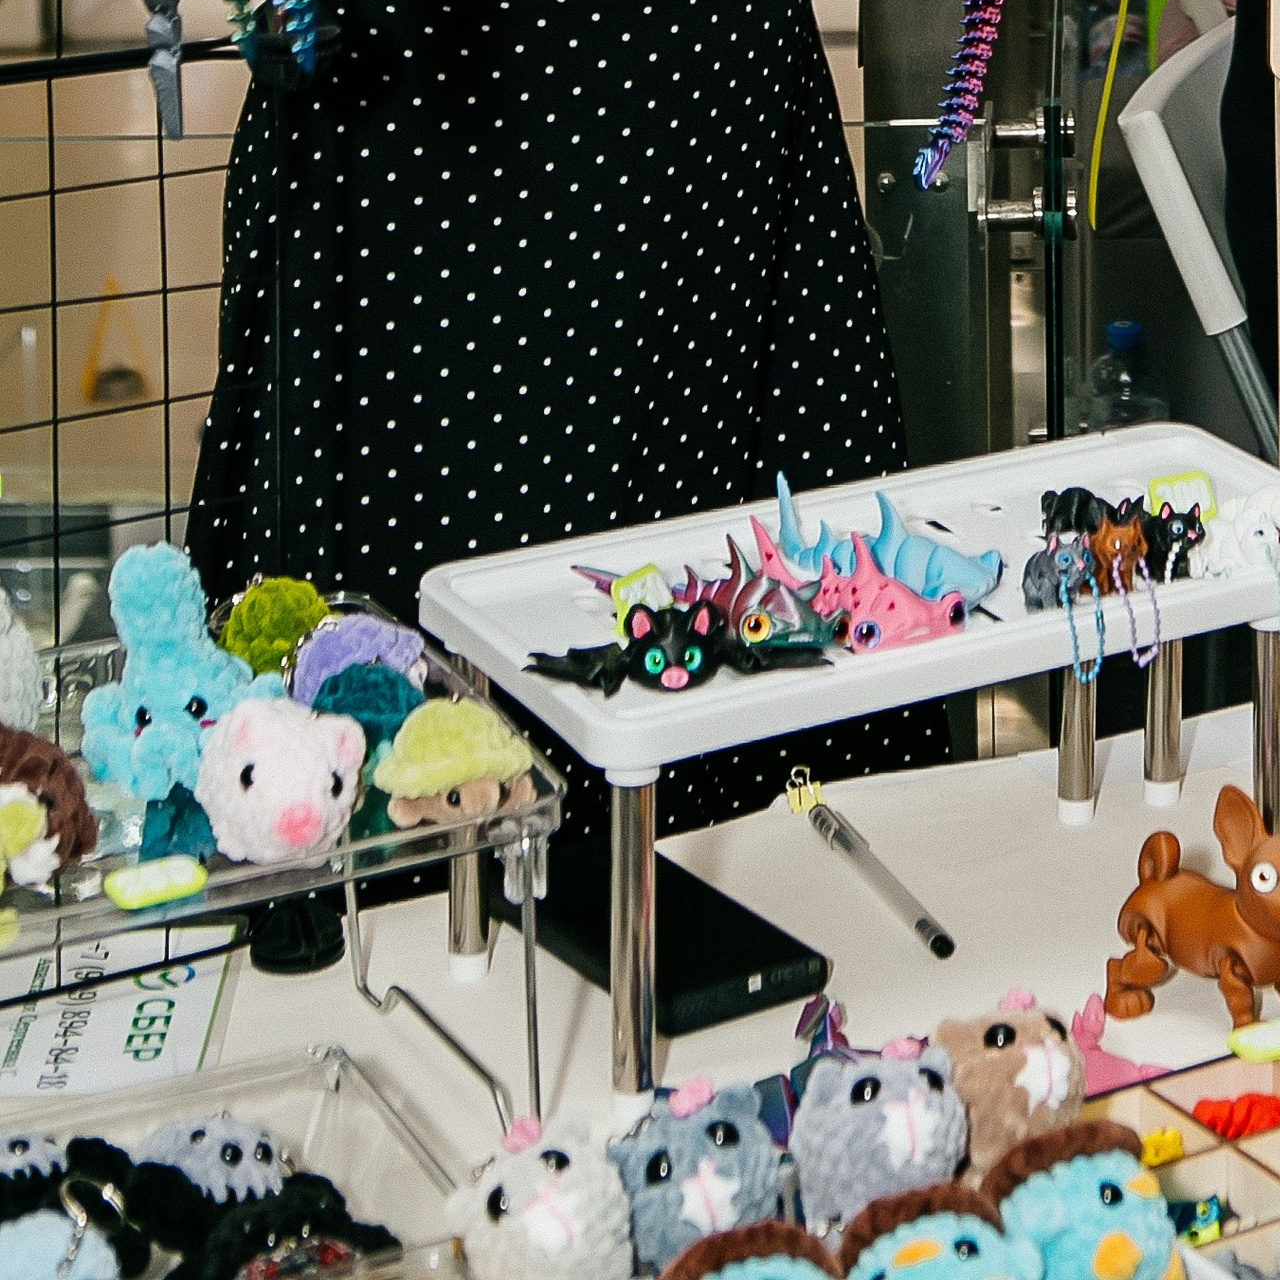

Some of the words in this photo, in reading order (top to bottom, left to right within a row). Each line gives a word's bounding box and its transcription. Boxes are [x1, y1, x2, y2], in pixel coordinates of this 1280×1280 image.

[57, 965, 107, 1006] (99)
[37, 1010, 91, 1090] 894-84-18
[123, 998, 176, 1062] СБЕР
